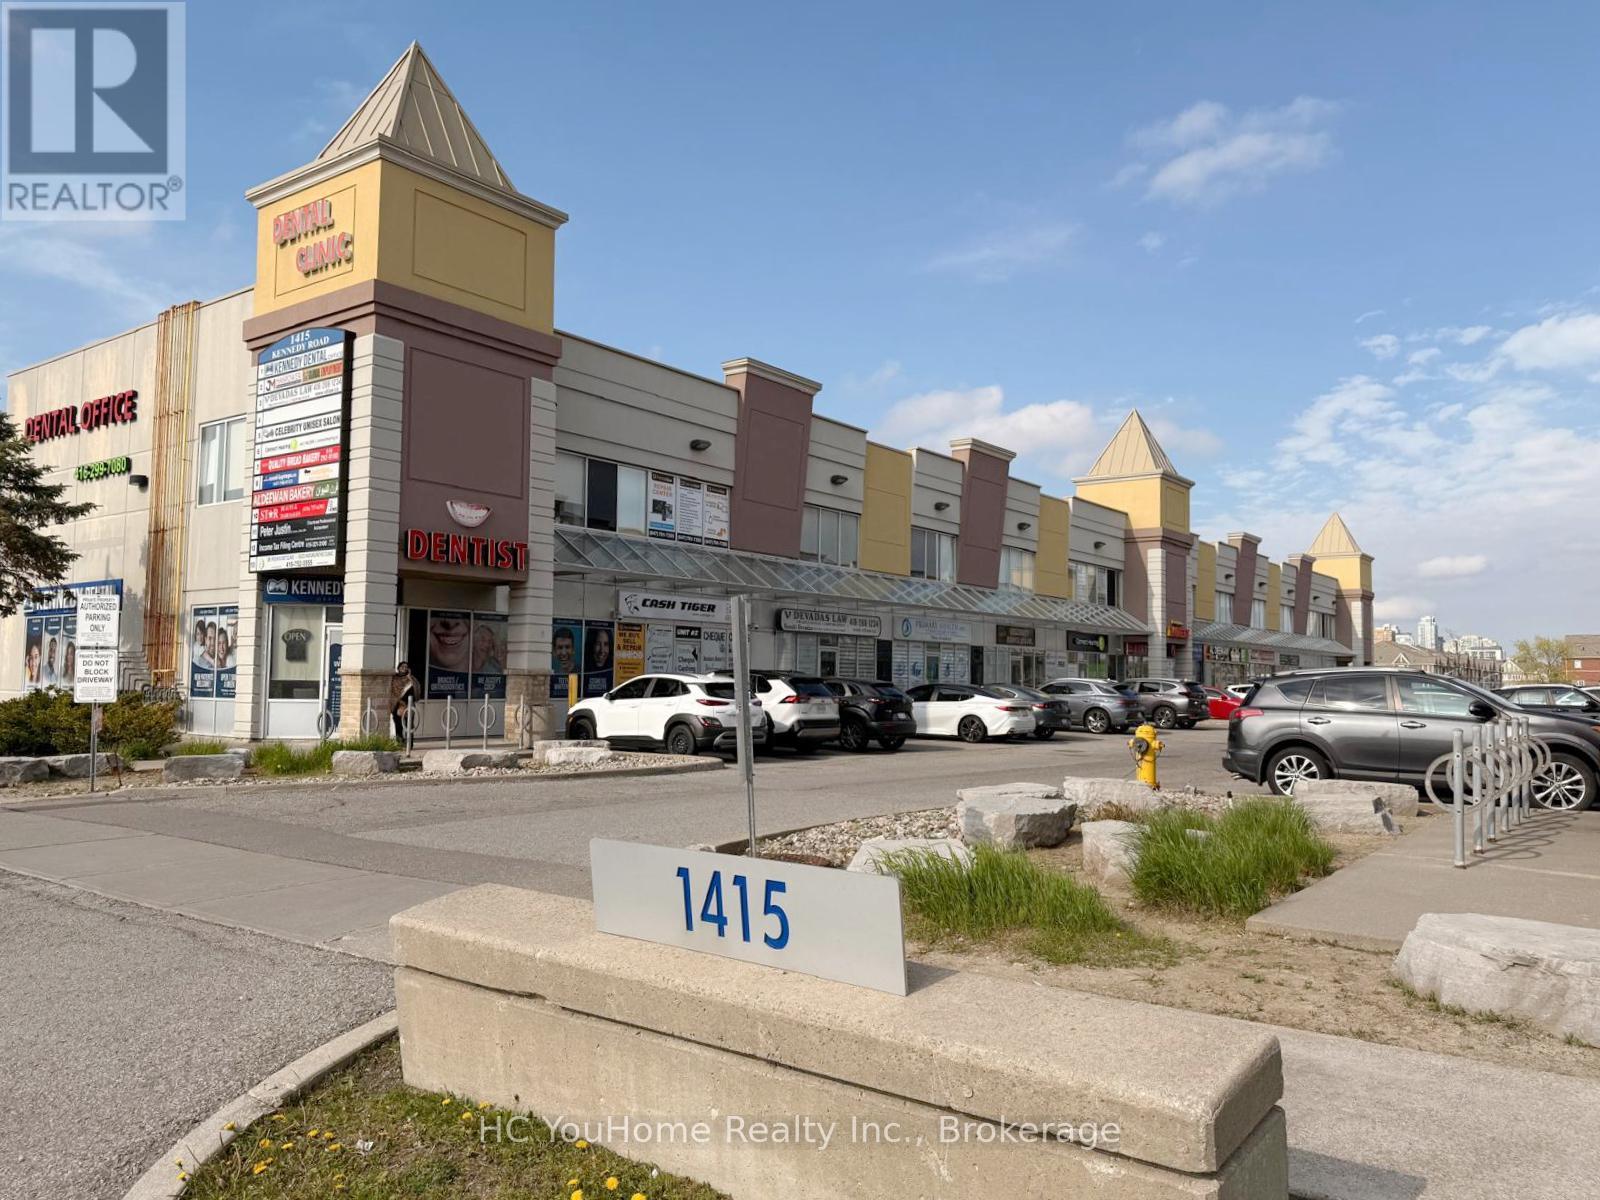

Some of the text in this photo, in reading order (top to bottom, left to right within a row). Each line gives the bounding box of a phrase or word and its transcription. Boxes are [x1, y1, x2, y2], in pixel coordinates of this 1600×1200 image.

[273, 198, 335, 247] DENTAL
[296, 231, 353, 275] CLINIC
[290, 330, 310, 344] 1415
[271, 336, 329, 359] KENNEDY ROAD
[274, 356, 302, 374] KENNEDY
[303, 349, 327, 366] DENTAL
[300, 384, 312, 395] LAW
[25, 390, 137, 442] DENTAL OFFICE
[275, 414, 340, 437] CELEBRITY UNISEX SALON
[286, 456, 302, 466] BREAD
[302, 452, 321, 464] BAKERY
[289, 486, 314, 500] BAKERY
[260, 526, 274, 537] Peter
[259, 543, 273, 551] Income
[407, 528, 528, 571] DENTIST
[641, 598, 716, 613] CASH TIGER
[85, 613, 111, 622] PARKING
[793, 611, 830, 622] DEVADAS
[832, 613, 847, 623] LAW
[89, 624, 106, 632] ONLY
[285, 632, 306, 641] OPEN
[703, 631, 726, 641] CHEQUE
[676, 866, 790, 950] 1415
